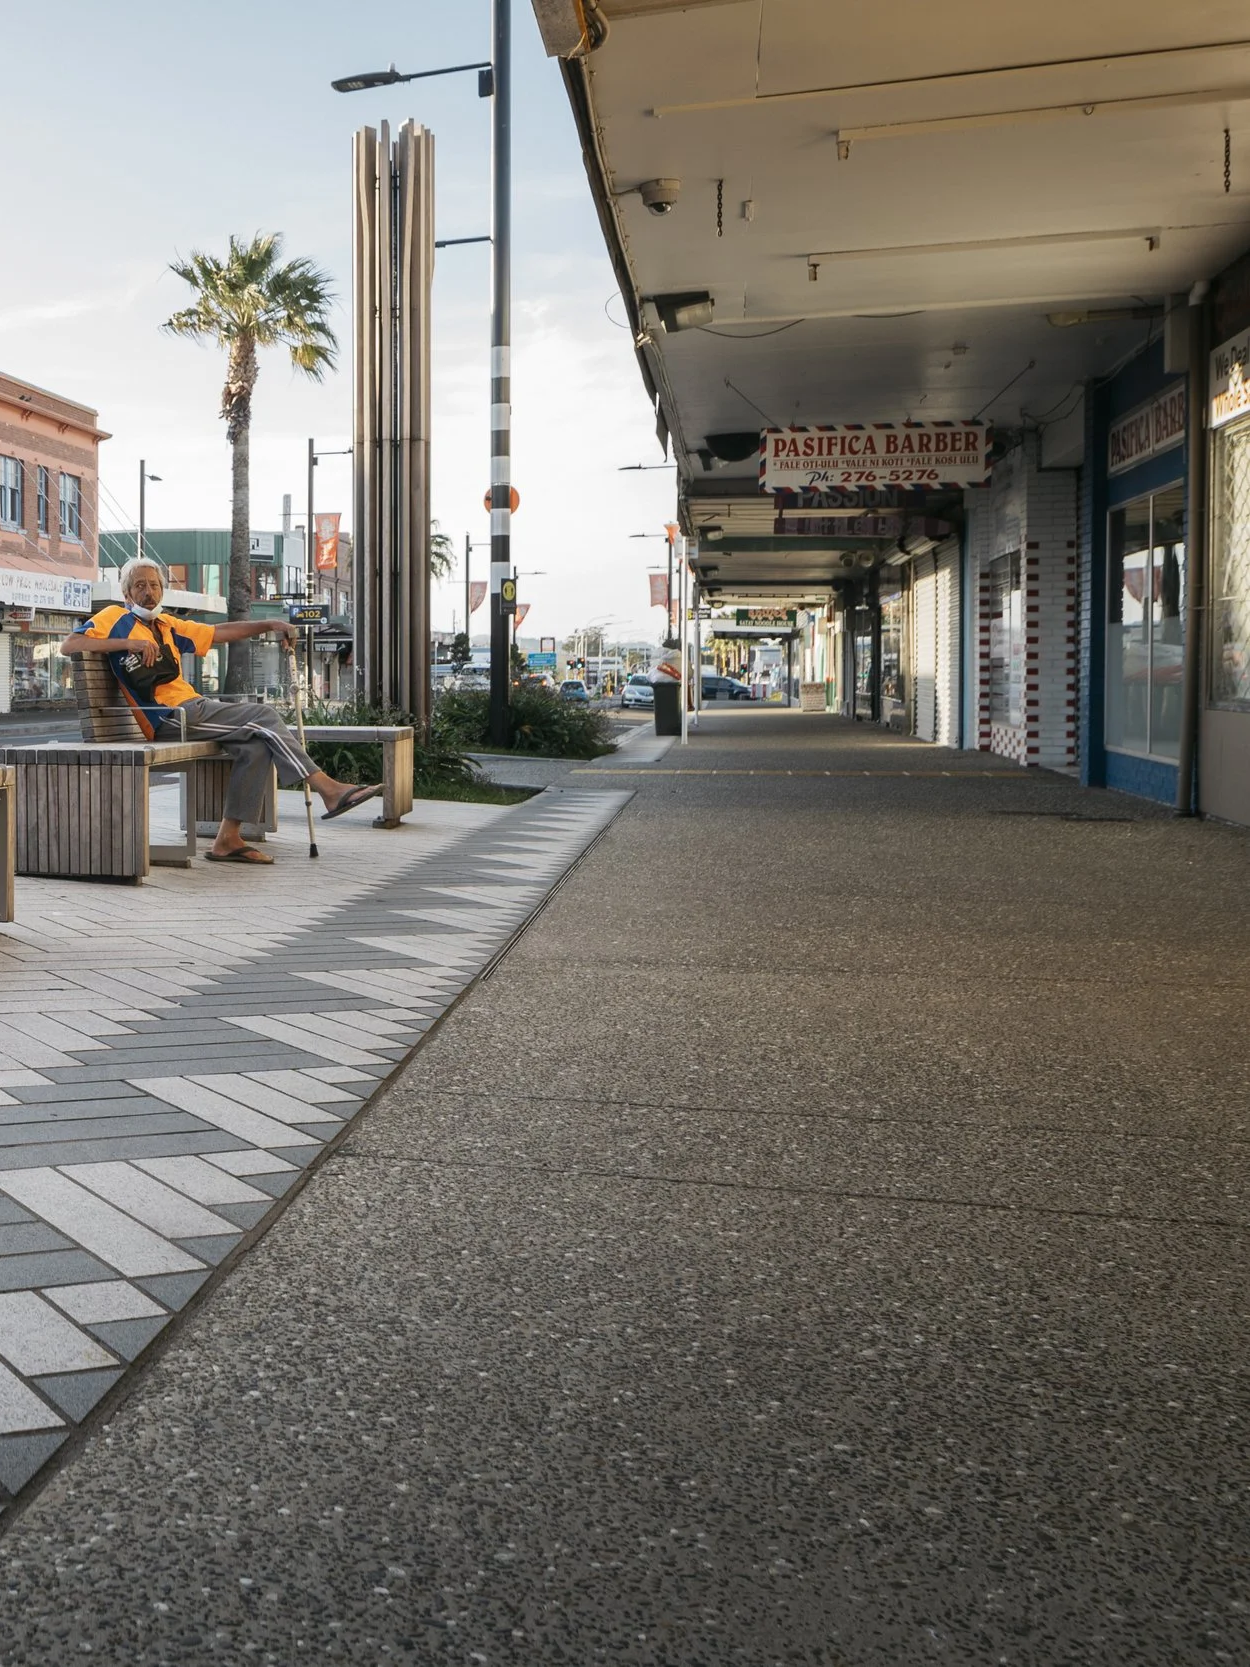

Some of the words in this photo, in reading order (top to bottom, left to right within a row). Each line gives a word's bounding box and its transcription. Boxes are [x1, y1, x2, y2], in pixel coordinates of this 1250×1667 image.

[1215, 353, 1229, 381] We
[773, 435, 877, 458] PASIFICA
[885, 431, 979, 455] BARBER
[1111, 412, 1150, 467] PASIFICA
[779, 460, 801, 469] FALE
[869, 459, 880, 468] NI
[882, 458, 904, 467] KOTI
[935, 456, 957, 465] KOSI
[959, 455, 979, 464] ULU
[841, 468, 939, 483] 276-5276
[797, 489, 898, 508] PASSION
[305, 610, 321, 618] 102
